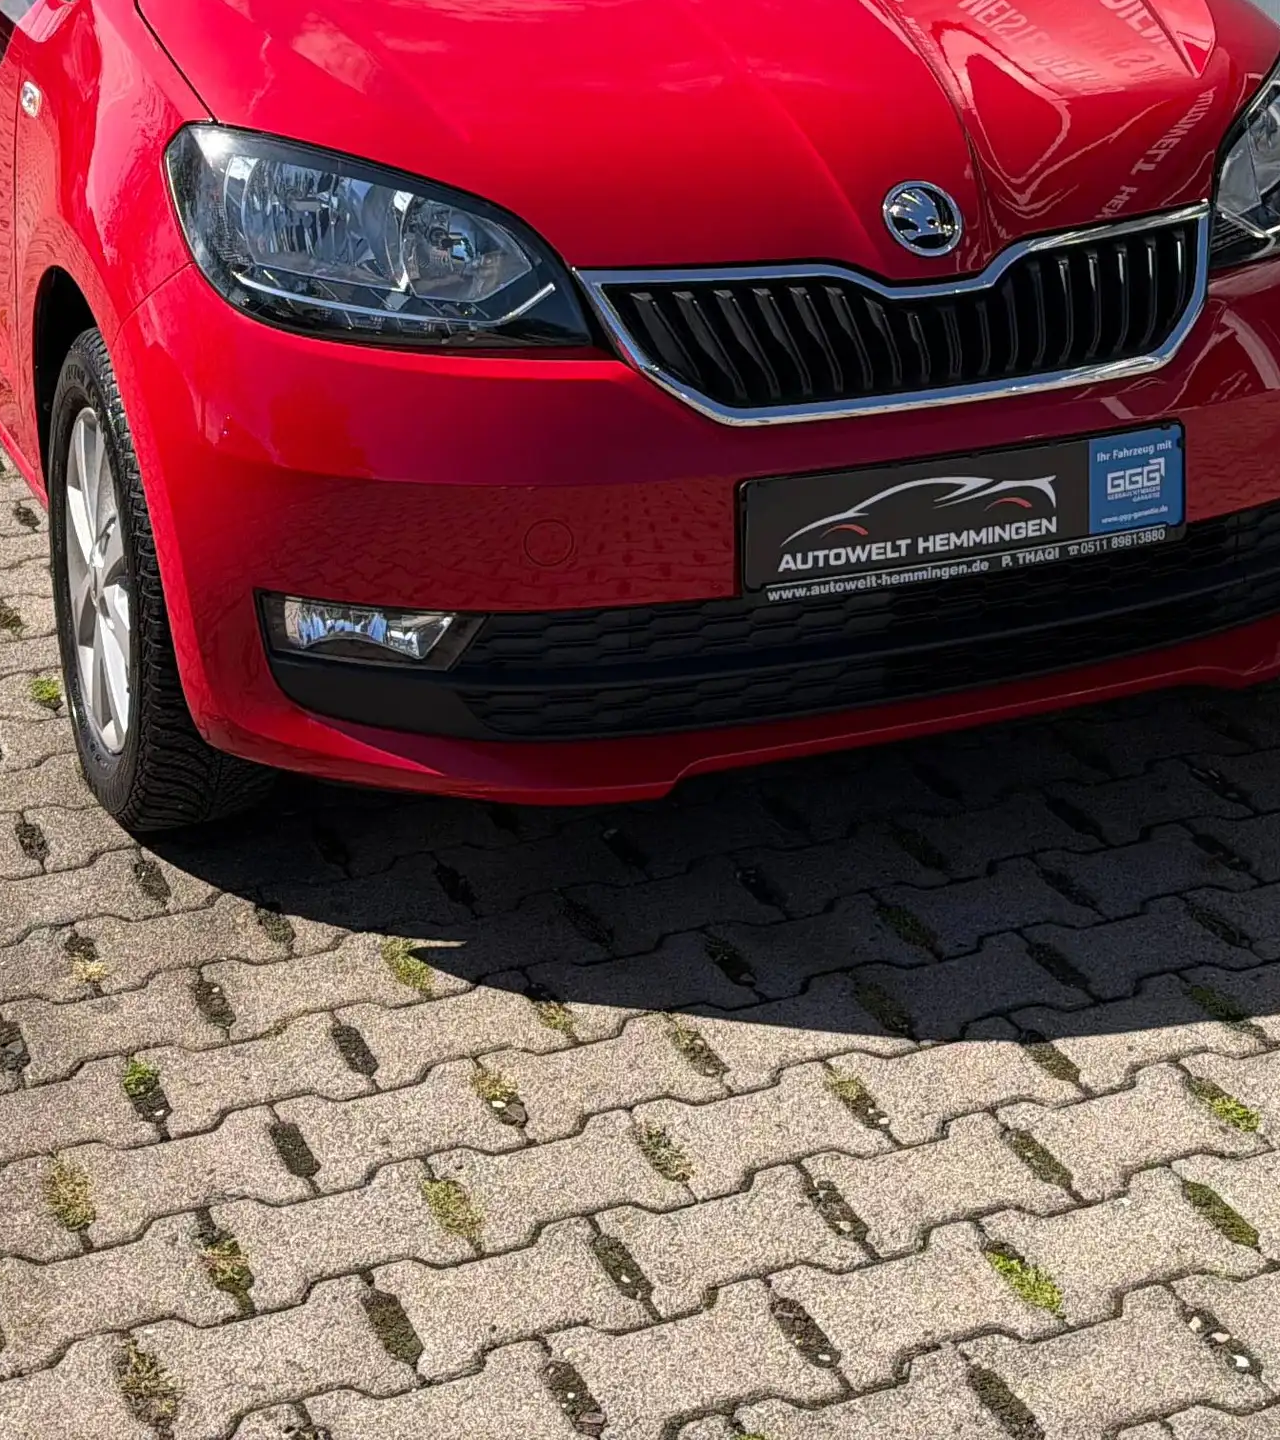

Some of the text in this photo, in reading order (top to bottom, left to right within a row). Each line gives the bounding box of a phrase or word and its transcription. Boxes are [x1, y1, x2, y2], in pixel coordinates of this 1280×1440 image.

[1096, 439, 1173, 463] Ihr Fahrzeug mit
[1106, 459, 1163, 494] GGG
[777, 516, 1058, 573] AUTOWELT HEMMINGEN
[767, 559, 990, 602] www.autowelt-hemmingen.de
[1001, 555, 1013, 568] P.
[1018, 548, 1060, 565] THAQI
[1080, 539, 1108, 555] 0511
